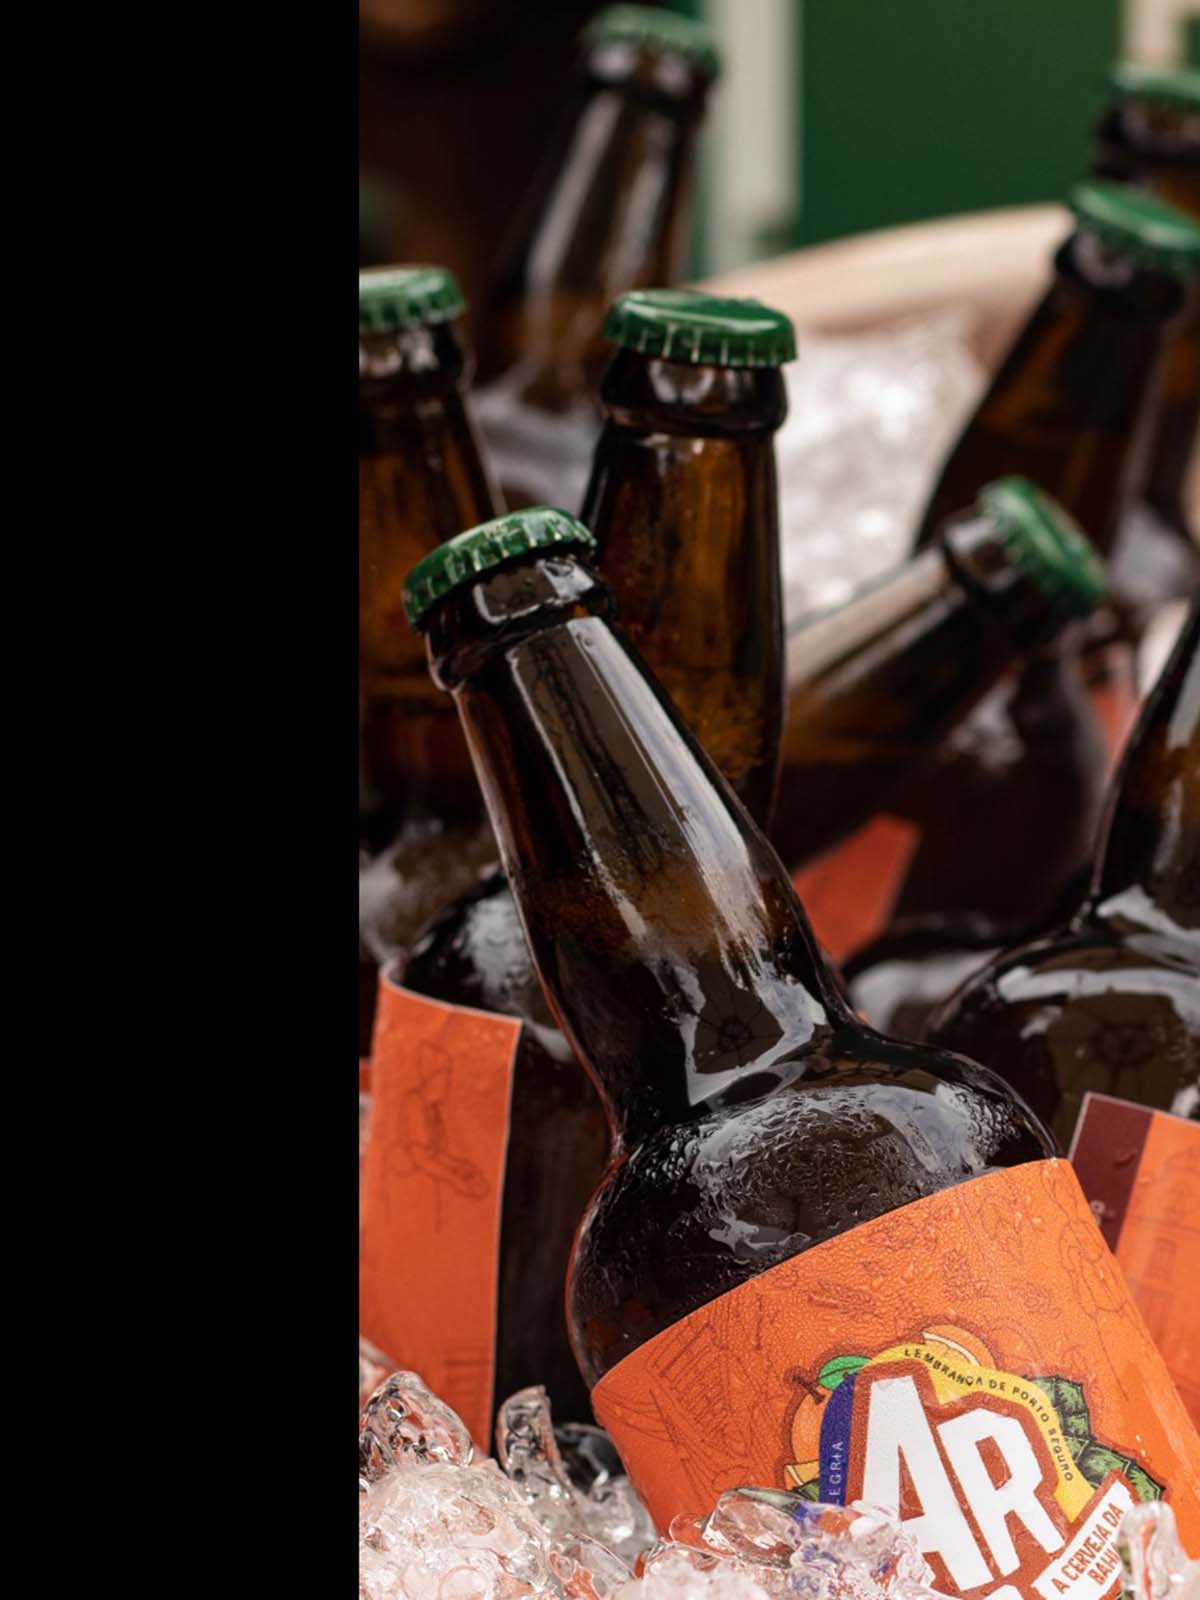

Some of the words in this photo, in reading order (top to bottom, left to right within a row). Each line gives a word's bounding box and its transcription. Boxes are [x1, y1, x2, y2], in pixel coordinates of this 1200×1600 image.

[904, 1348, 983, 1386] LEMBRANÇA
[988, 1378, 1006, 1391] DE
[1012, 1386, 1049, 1422] PORTO
[1048, 1428, 1074, 1482] SEGURO
[1051, 1578, 1070, 1594] A
[1061, 1524, 1112, 1581] CERVEJA
[1102, 1502, 1124, 1528] DA
